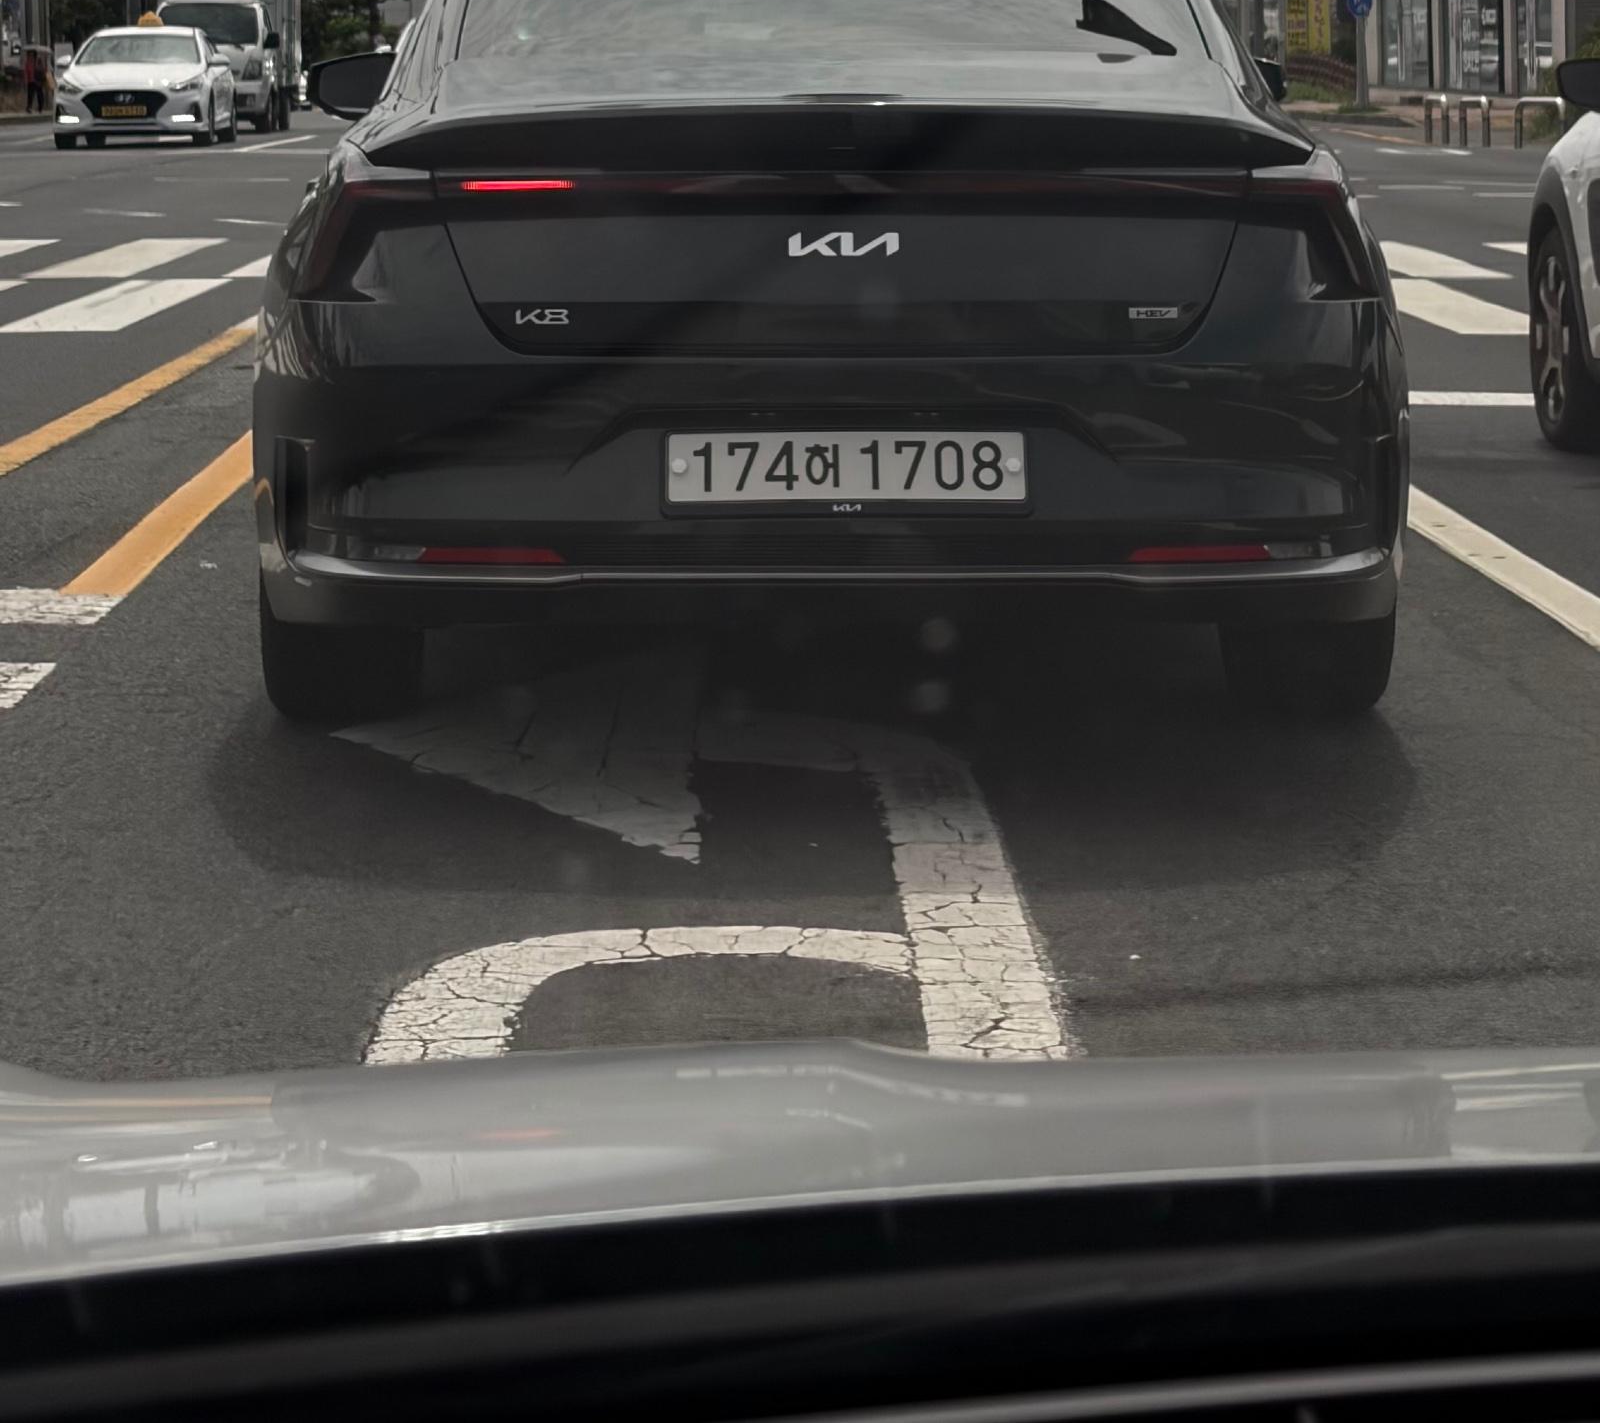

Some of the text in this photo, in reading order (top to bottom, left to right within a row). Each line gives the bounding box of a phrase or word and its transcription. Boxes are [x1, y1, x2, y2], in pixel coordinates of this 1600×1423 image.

[788, 232, 900, 257] KIA
[515, 308, 569, 325] K8
[1136, 309, 1171, 318] HEV
[692, 439, 1004, 492] 174허 1708
[832, 504, 862, 512] KIA
